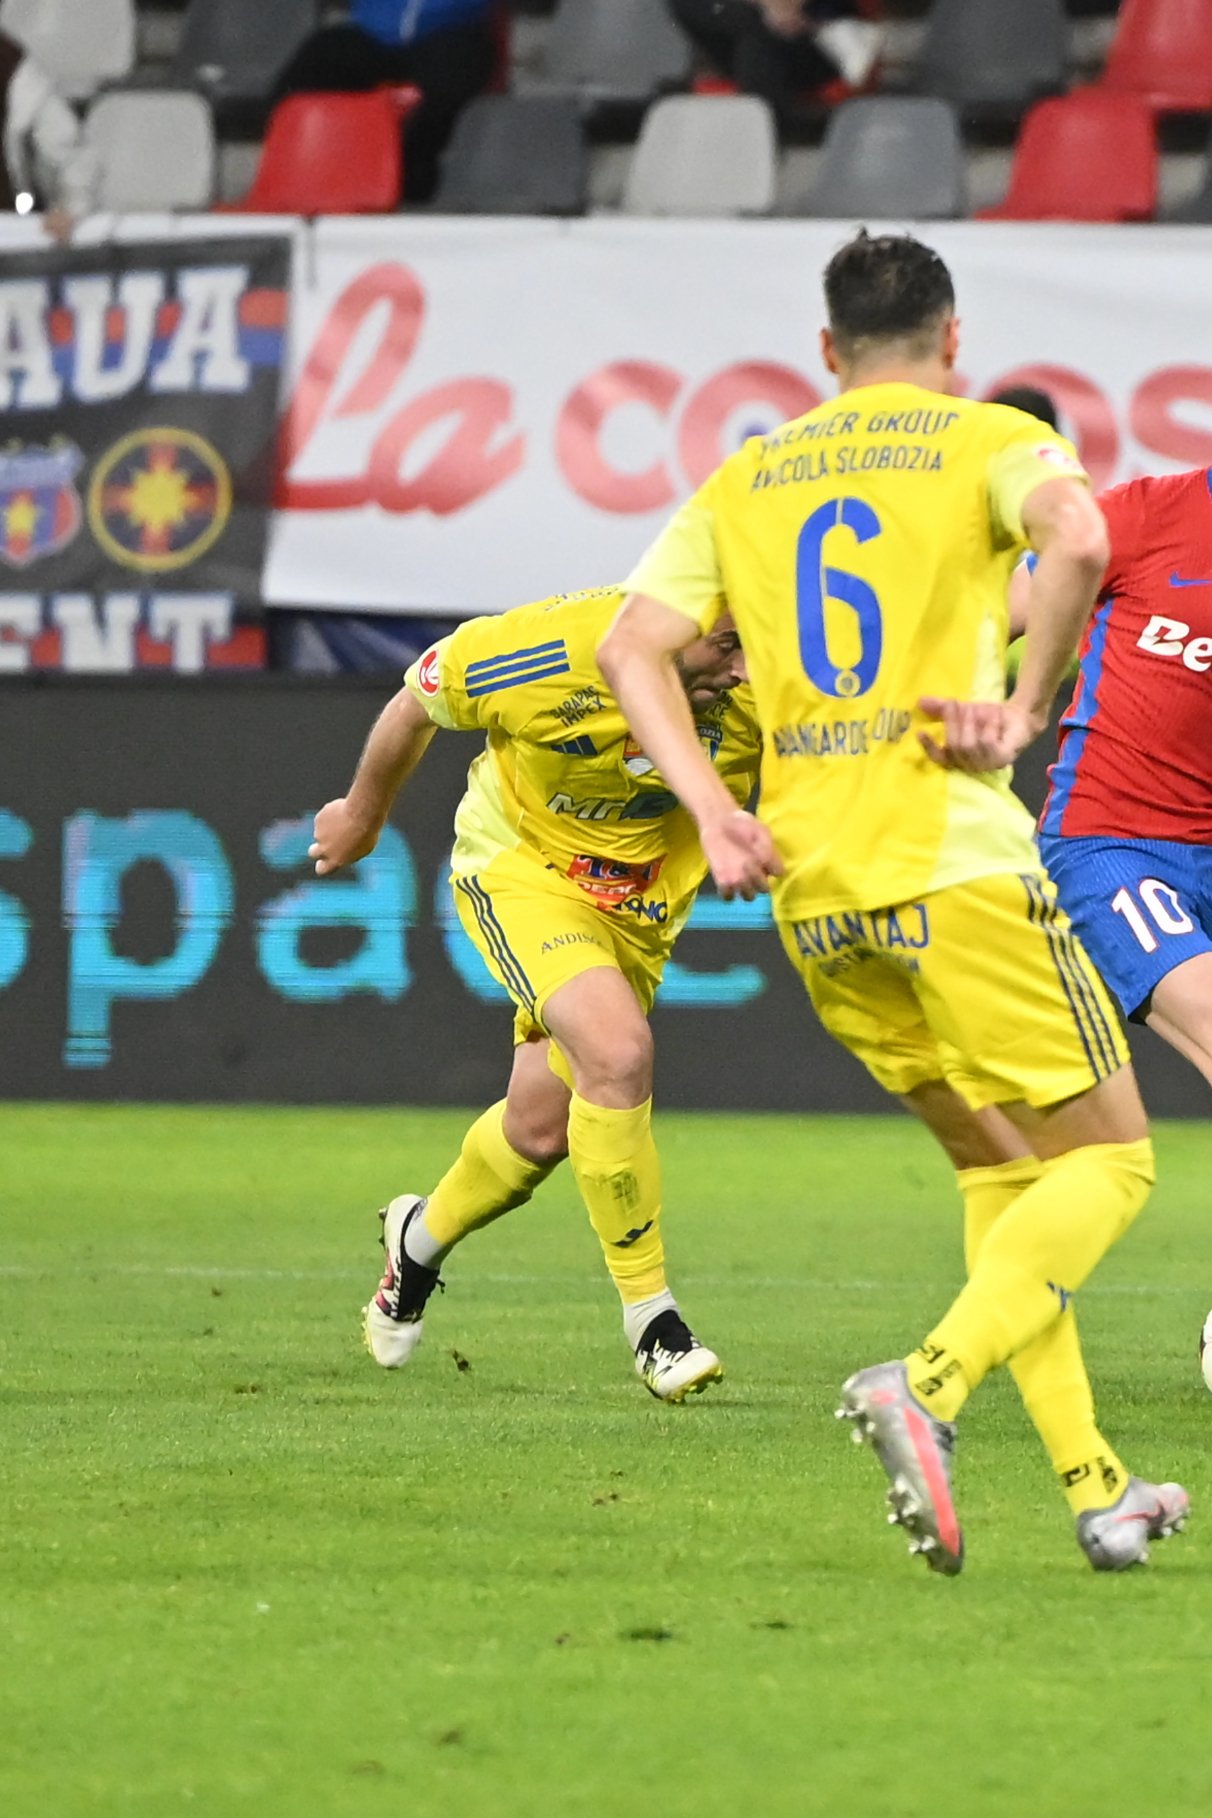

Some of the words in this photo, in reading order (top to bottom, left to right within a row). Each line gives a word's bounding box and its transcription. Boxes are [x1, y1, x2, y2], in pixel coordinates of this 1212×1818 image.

[836, 446, 943, 475] SLOBOZIA
[795, 496, 882, 698] 6
[561, 697, 607, 729] IMPEX
[546, 792, 680, 821] MrB
[1111, 877, 1195, 955] 10
